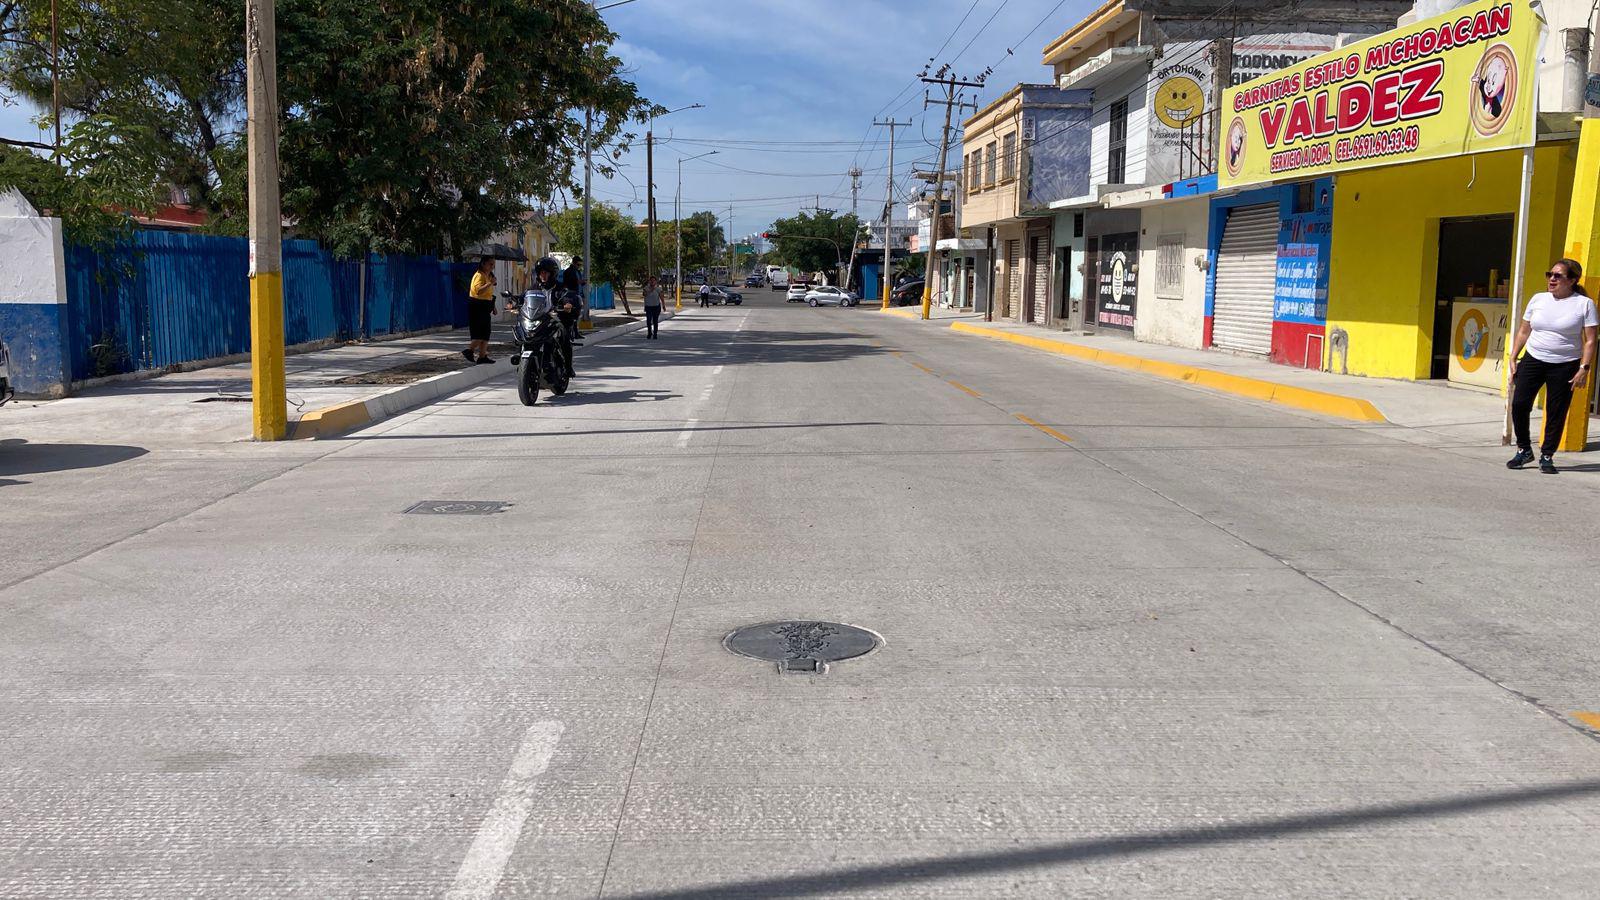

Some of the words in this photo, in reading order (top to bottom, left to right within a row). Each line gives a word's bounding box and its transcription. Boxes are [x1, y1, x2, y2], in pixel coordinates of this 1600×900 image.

[1157, 64, 1206, 82] ORTOHOME
[1233, 72, 1300, 112] CARNITAS
[1304, 53, 1361, 91] ESTILO
[1364, 3, 1512, 74] MICHOACAN
[1259, 58, 1445, 150] VALDEZ
[1270, 147, 1302, 174] SERVICIO
[1302, 144, 1311, 168] A
[1311, 141, 1333, 168] DOM.
